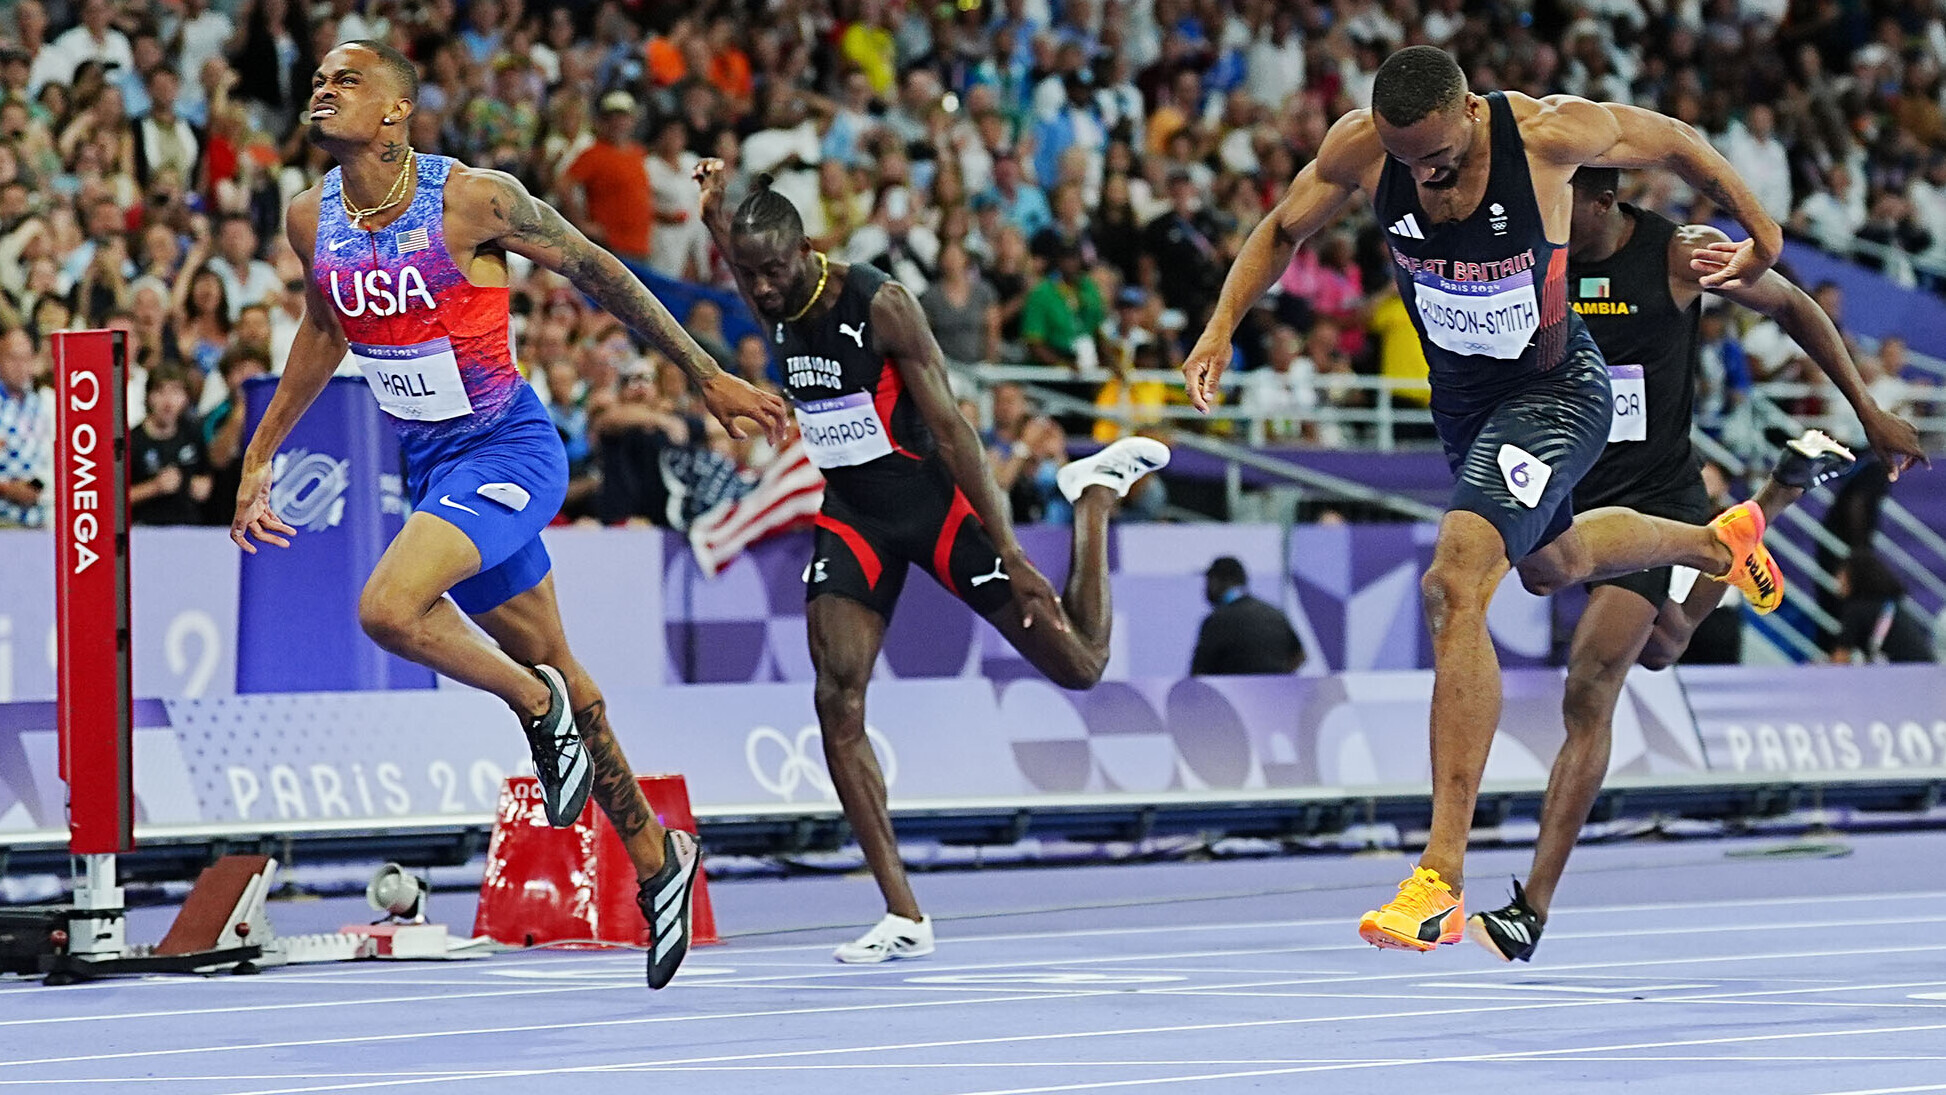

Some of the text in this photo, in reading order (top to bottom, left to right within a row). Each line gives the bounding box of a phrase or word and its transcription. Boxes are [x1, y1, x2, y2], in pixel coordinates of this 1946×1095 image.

[1453, 248, 1535, 282] BRITAIN
[329, 265, 437, 317] USA
[1439, 280, 1501, 293] PARIS 2024
[1420, 298, 1536, 334] HUDSON-SMITH
[1567, 301, 1629, 315] AMBIA
[377, 371, 436, 397] HALL
[1510, 461, 1530, 488] 6
[71, 423, 100, 574] OMEGA
